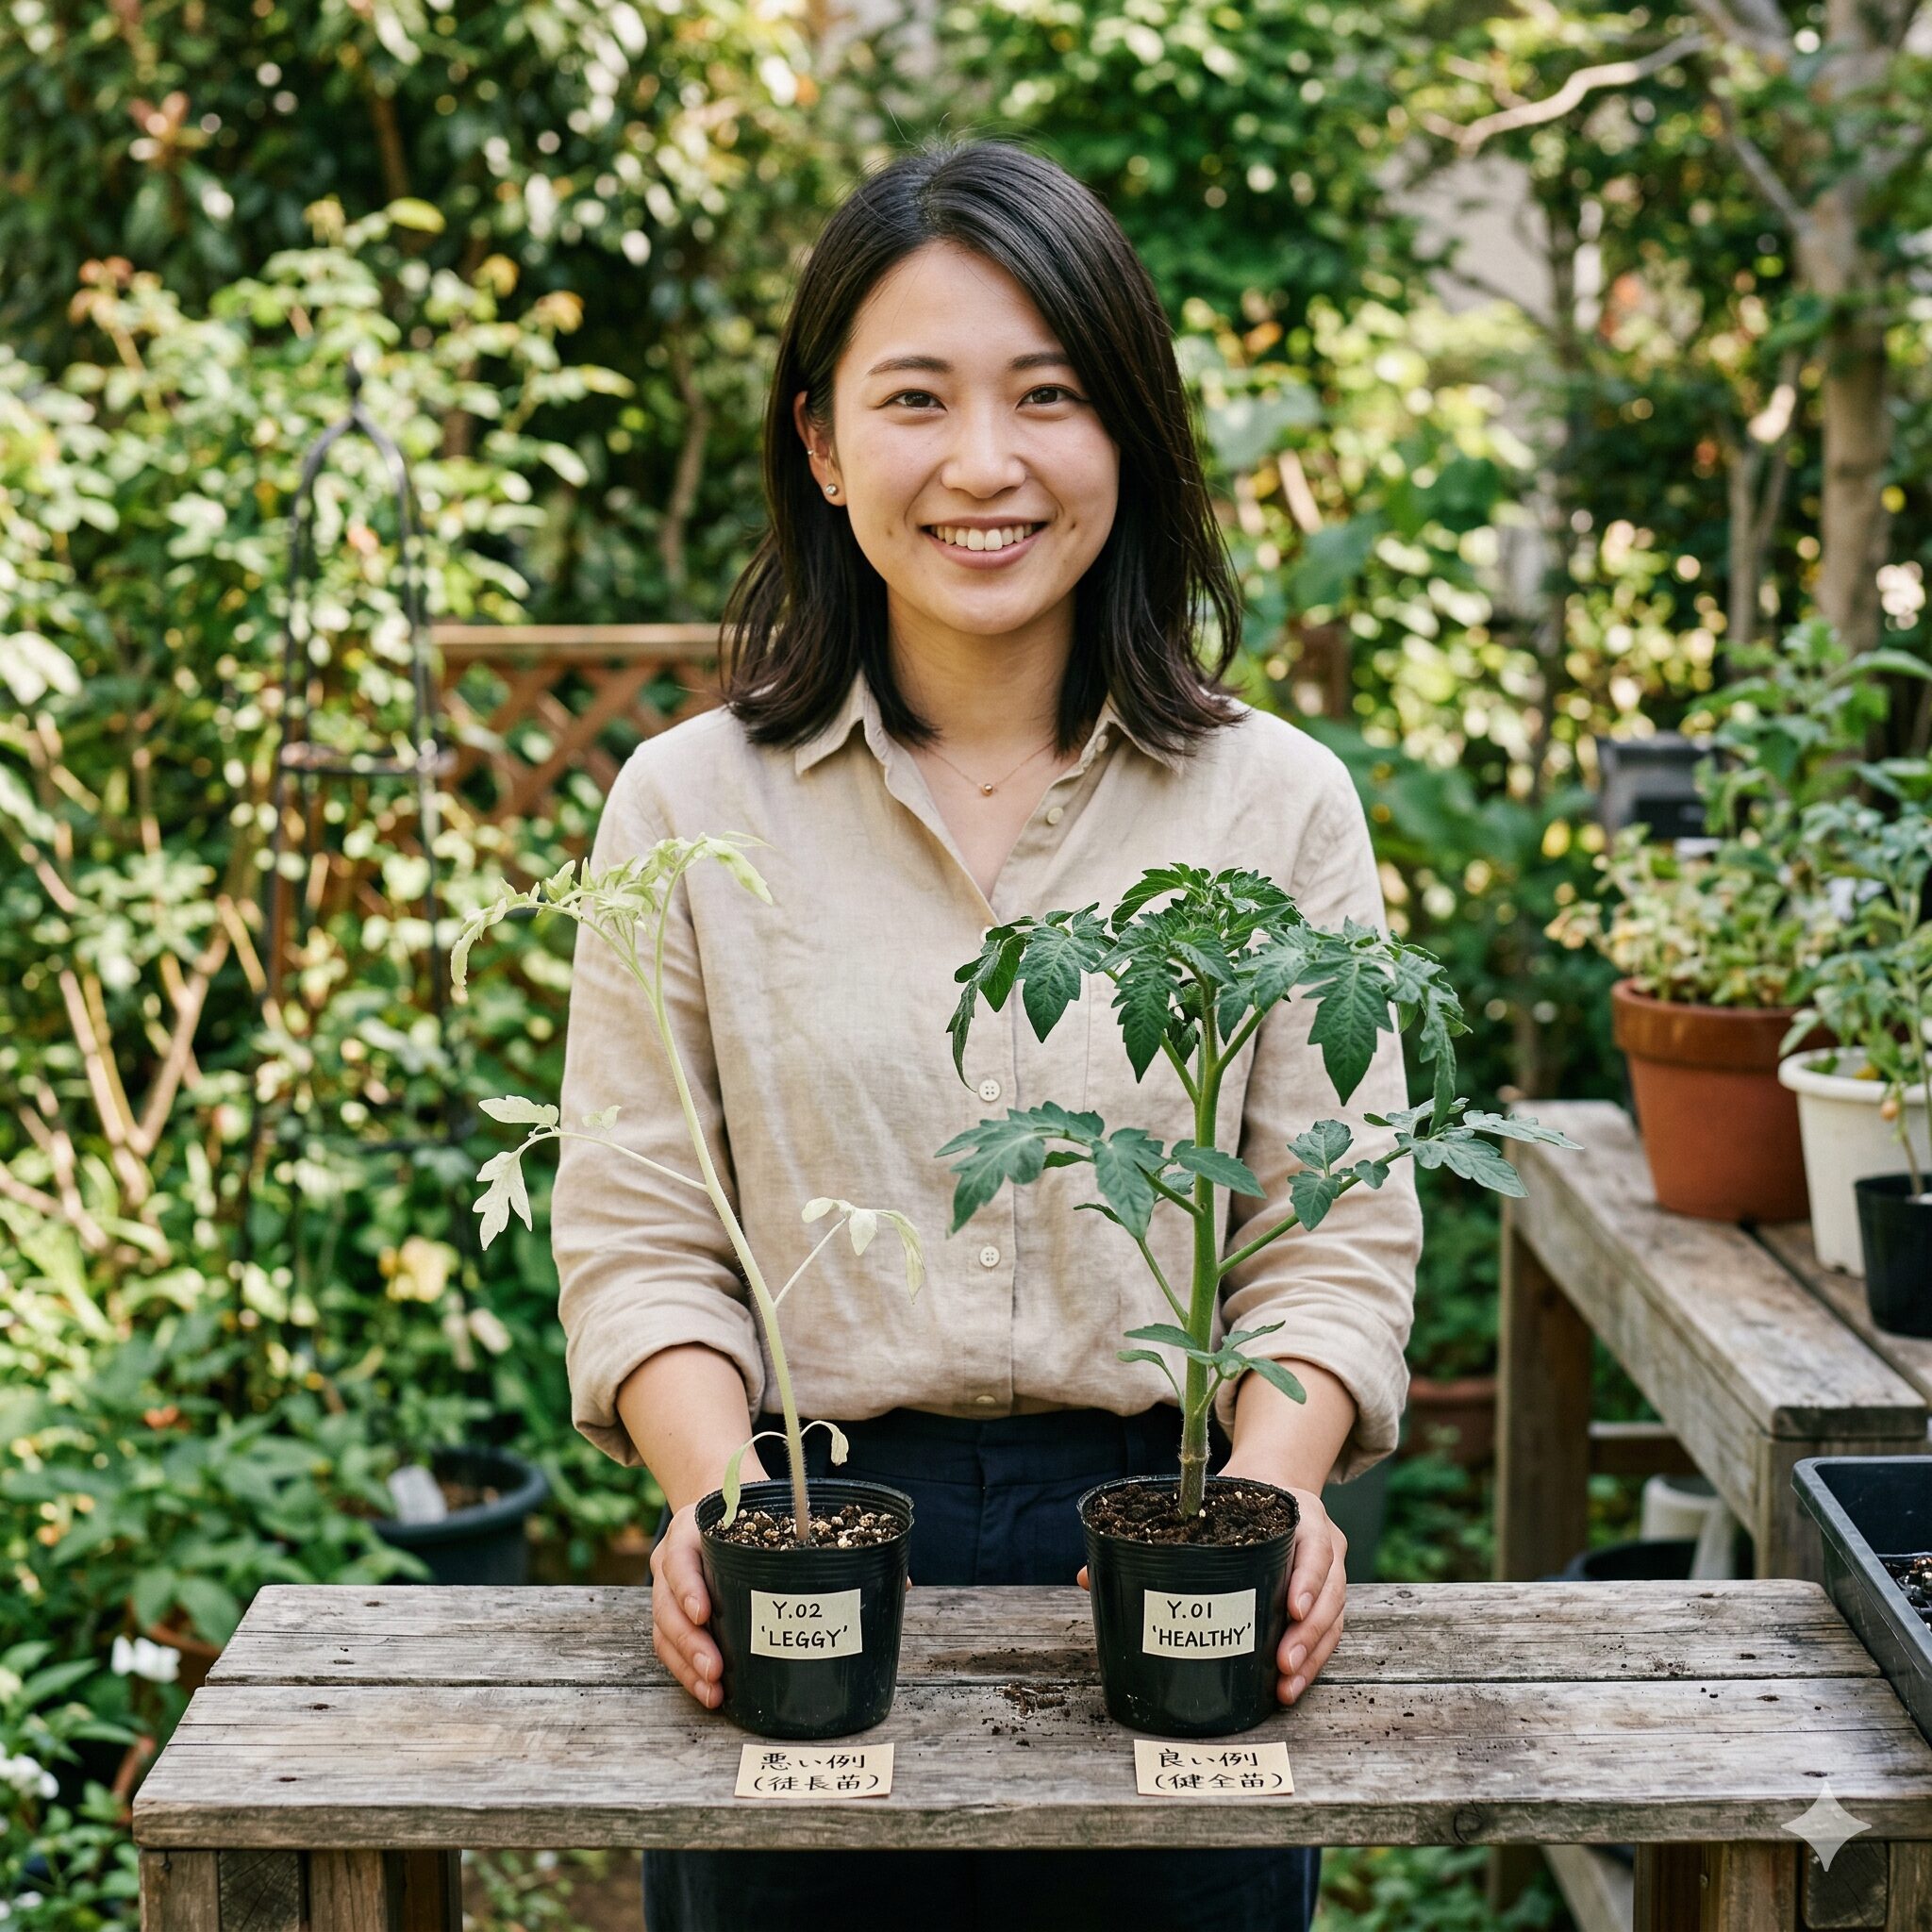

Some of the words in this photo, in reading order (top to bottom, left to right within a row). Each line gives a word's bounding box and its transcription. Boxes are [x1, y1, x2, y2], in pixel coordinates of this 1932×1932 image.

[772, 1600, 823, 1620] Y.02
[1166, 1600, 1213, 1620] Y.01
[760, 1625, 849, 1649] 'LEGGY'
[1152, 1622, 1252, 1648] 'HEALTHY'
[760, 1752, 865, 1771] 悪い例
[1158, 1748, 1258, 1768] 良い例
[754, 1774, 879, 1791] (徒長苗)
[1155, 1773, 1283, 1790] (健全苗)
